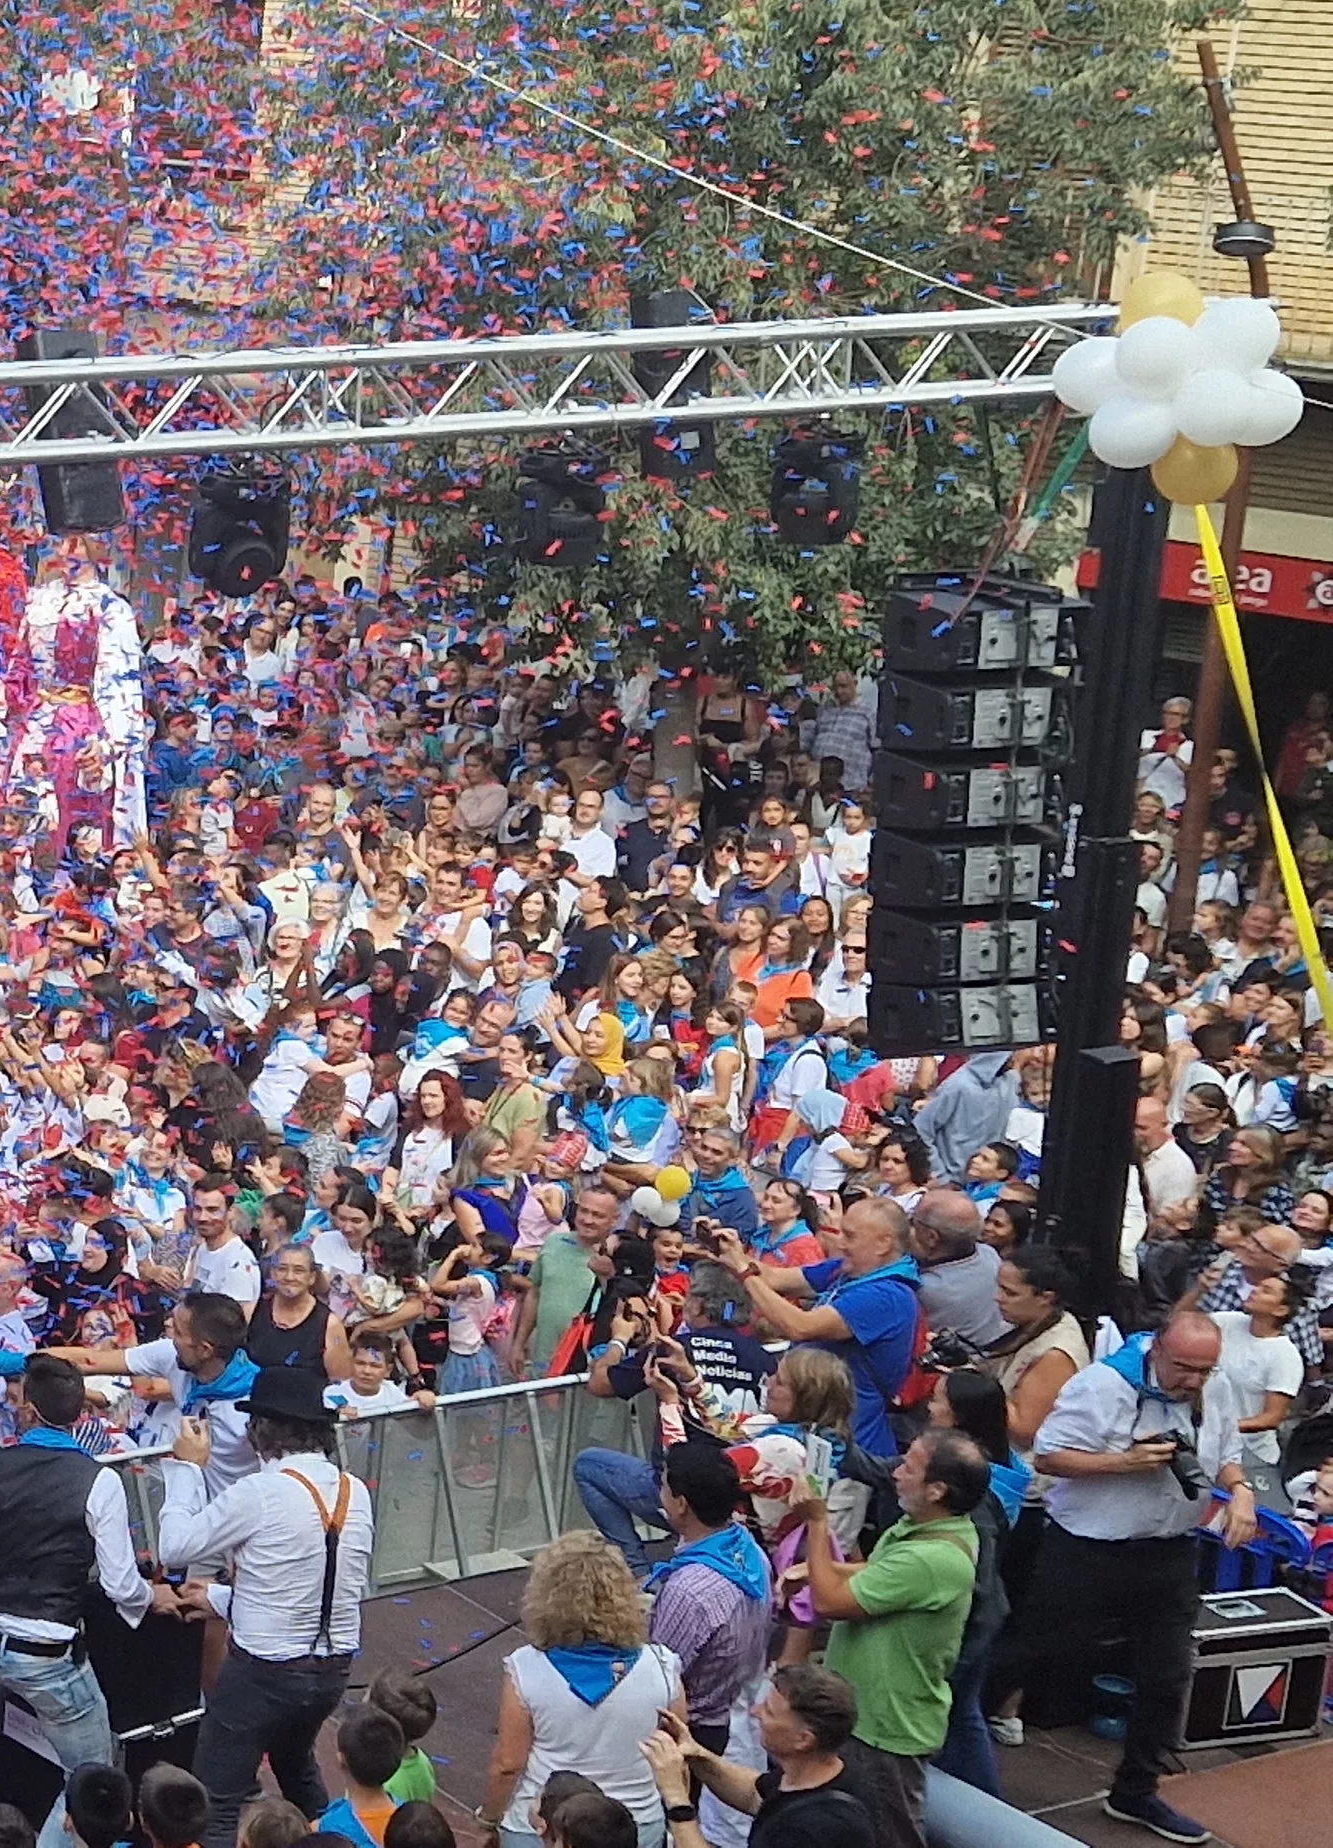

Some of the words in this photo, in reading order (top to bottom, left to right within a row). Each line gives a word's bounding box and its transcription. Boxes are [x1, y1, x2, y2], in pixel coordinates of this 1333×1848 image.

[1190, 560, 1273, 593] aea
[693, 1349, 737, 1365] Media
[695, 1364, 753, 1382] Noticias
